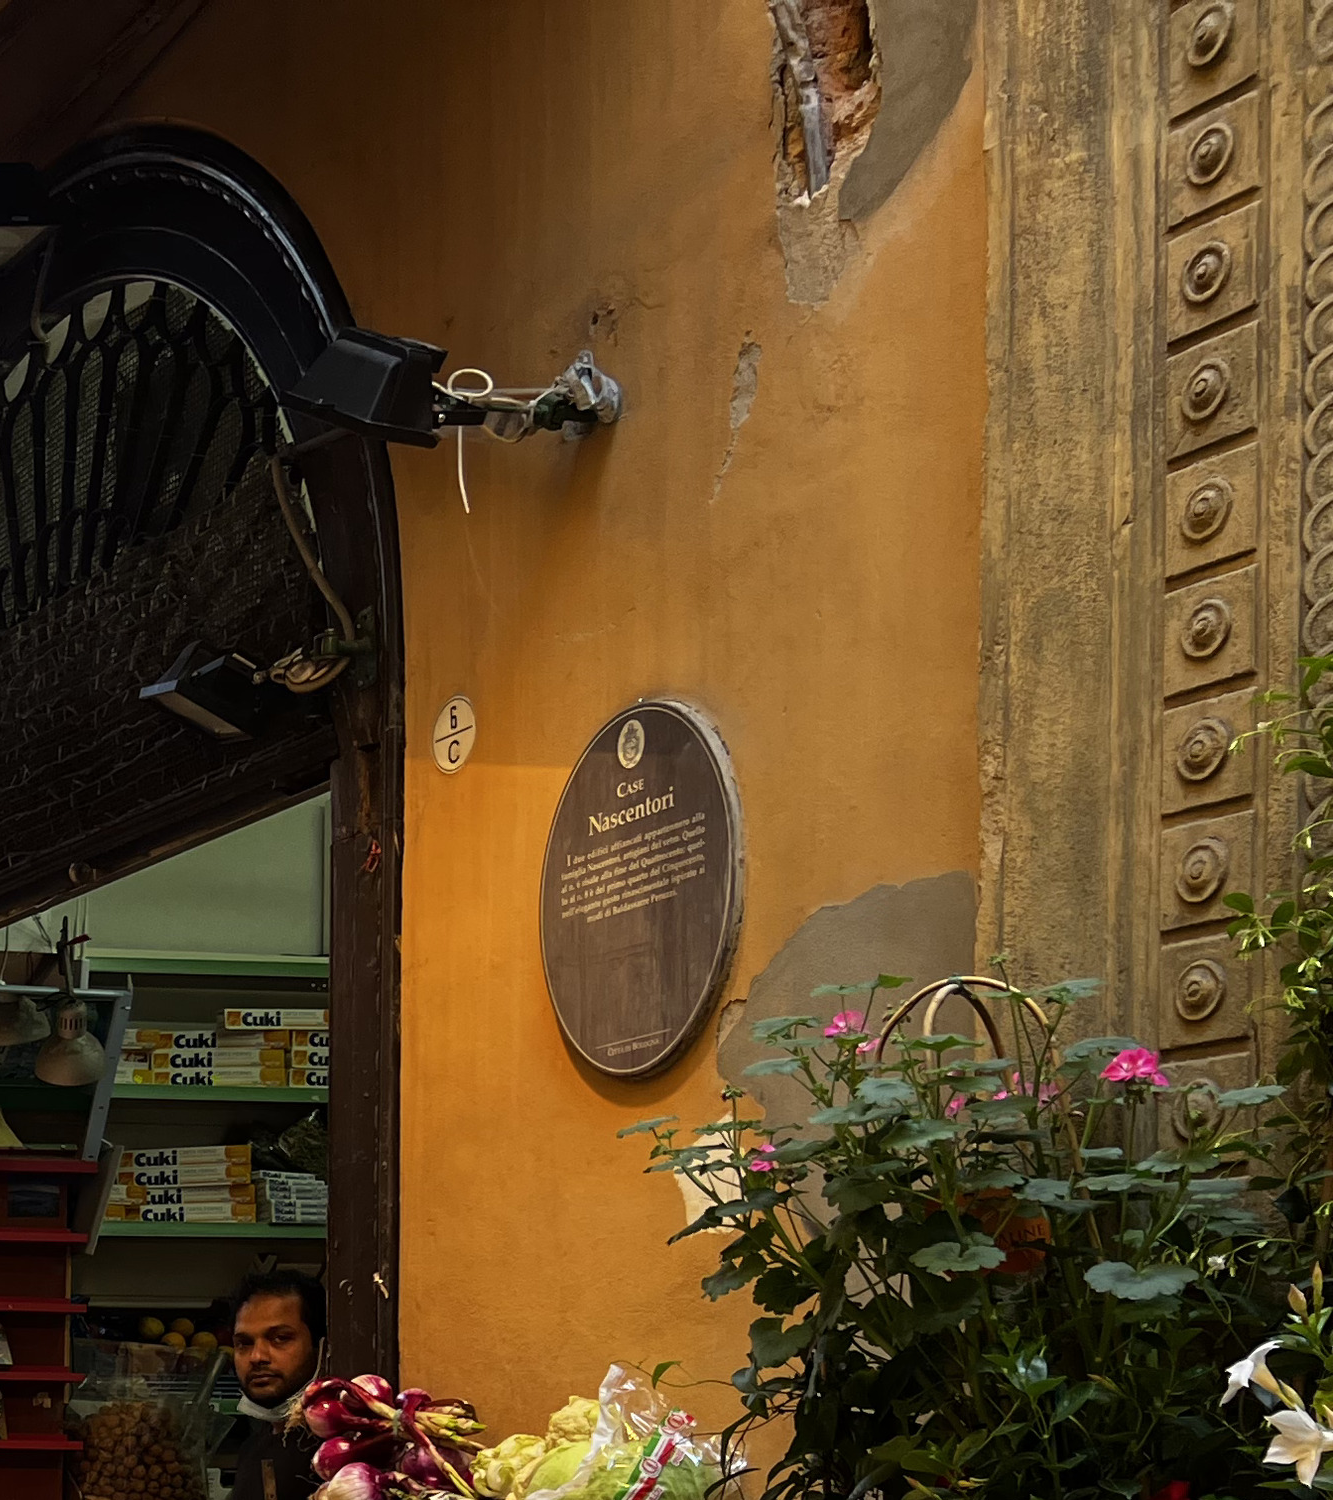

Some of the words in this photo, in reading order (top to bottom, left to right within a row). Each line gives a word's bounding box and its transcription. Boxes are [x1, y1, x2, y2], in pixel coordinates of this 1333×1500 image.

[449, 706, 458, 730] 6
[448, 740, 461, 764] C
[617, 779, 645, 797] CASE
[589, 786, 674, 836] Nascentori
[242, 1011, 281, 1027] Cuki
[173, 1033, 217, 1048] Cuki
[170, 1052, 212, 1068] Cuki
[171, 1071, 213, 1086] Cuki
[134, 1150, 177, 1167] Cuki
[135, 1170, 178, 1186] Cuki
[146, 1188, 182, 1205] uki
[141, 1207, 184, 1222] Cuki
